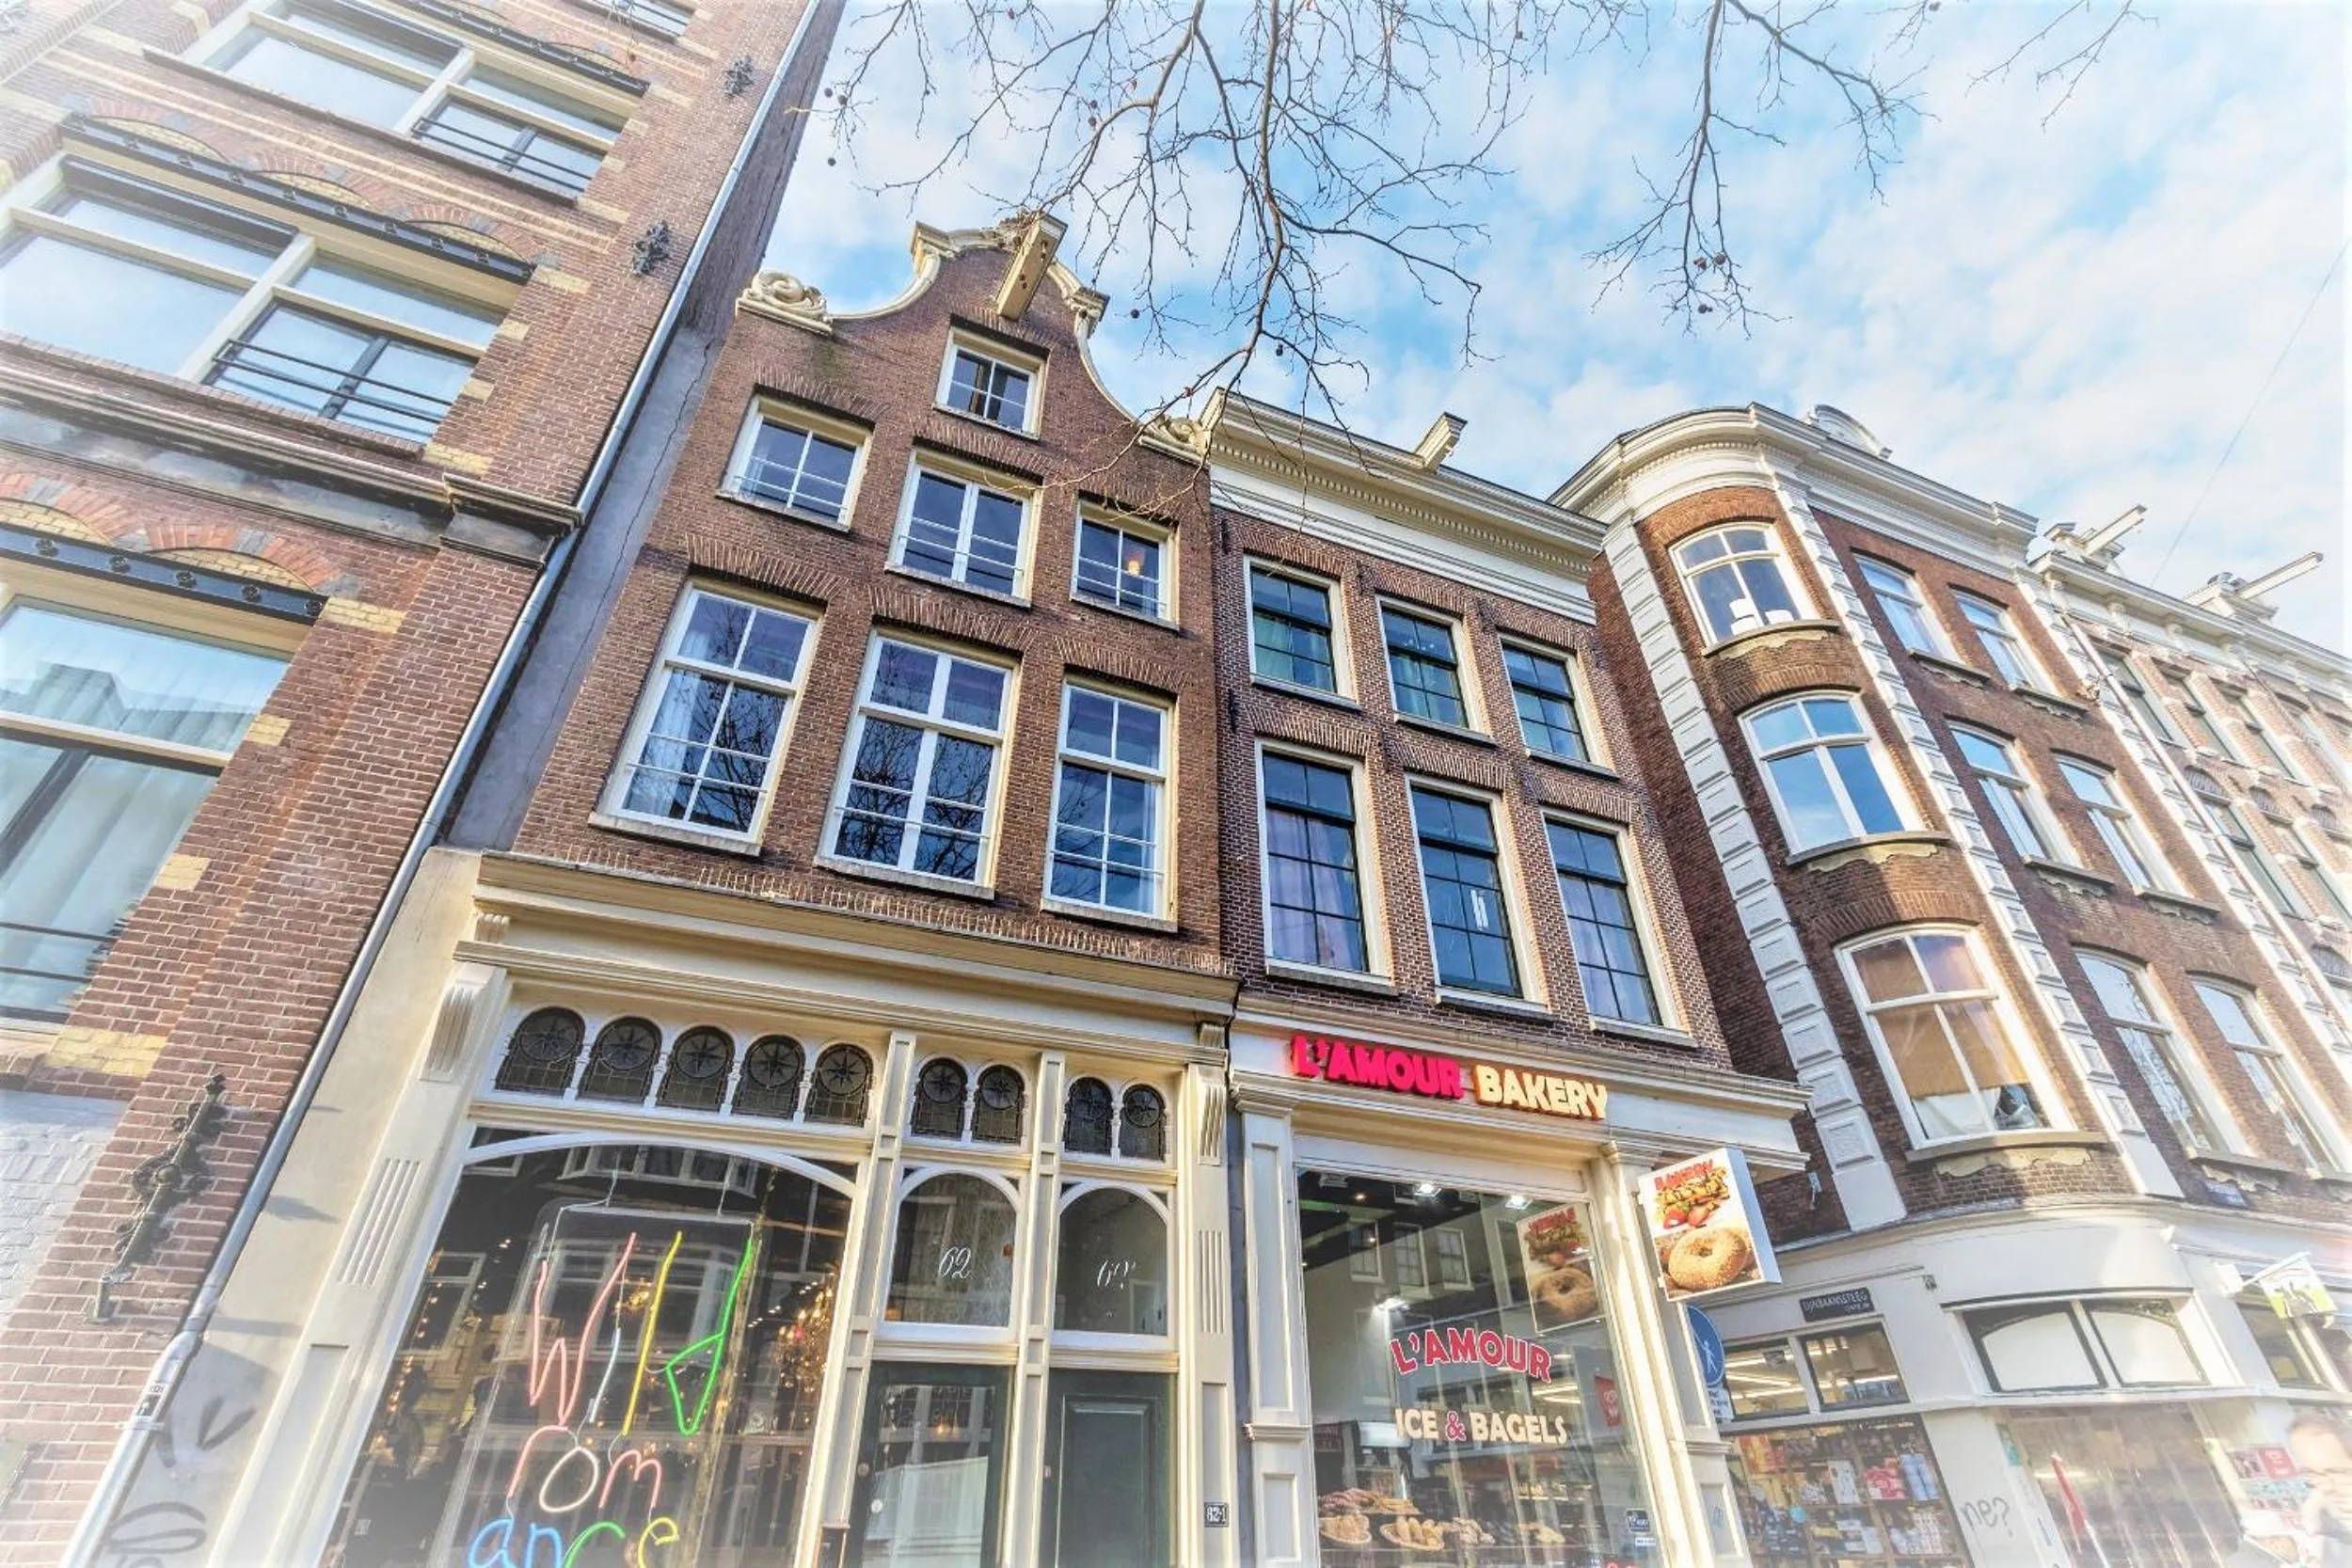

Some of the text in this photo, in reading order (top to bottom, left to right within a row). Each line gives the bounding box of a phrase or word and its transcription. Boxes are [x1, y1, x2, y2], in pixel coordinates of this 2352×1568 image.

[1291, 1036, 1608, 1121] L'AMOUR BAKERY
[938, 1246, 971, 1279] 62
[1389, 1327, 1551, 1384] L'AMOUR
[1394, 1408, 1567, 1445] ICE & BAGELS
